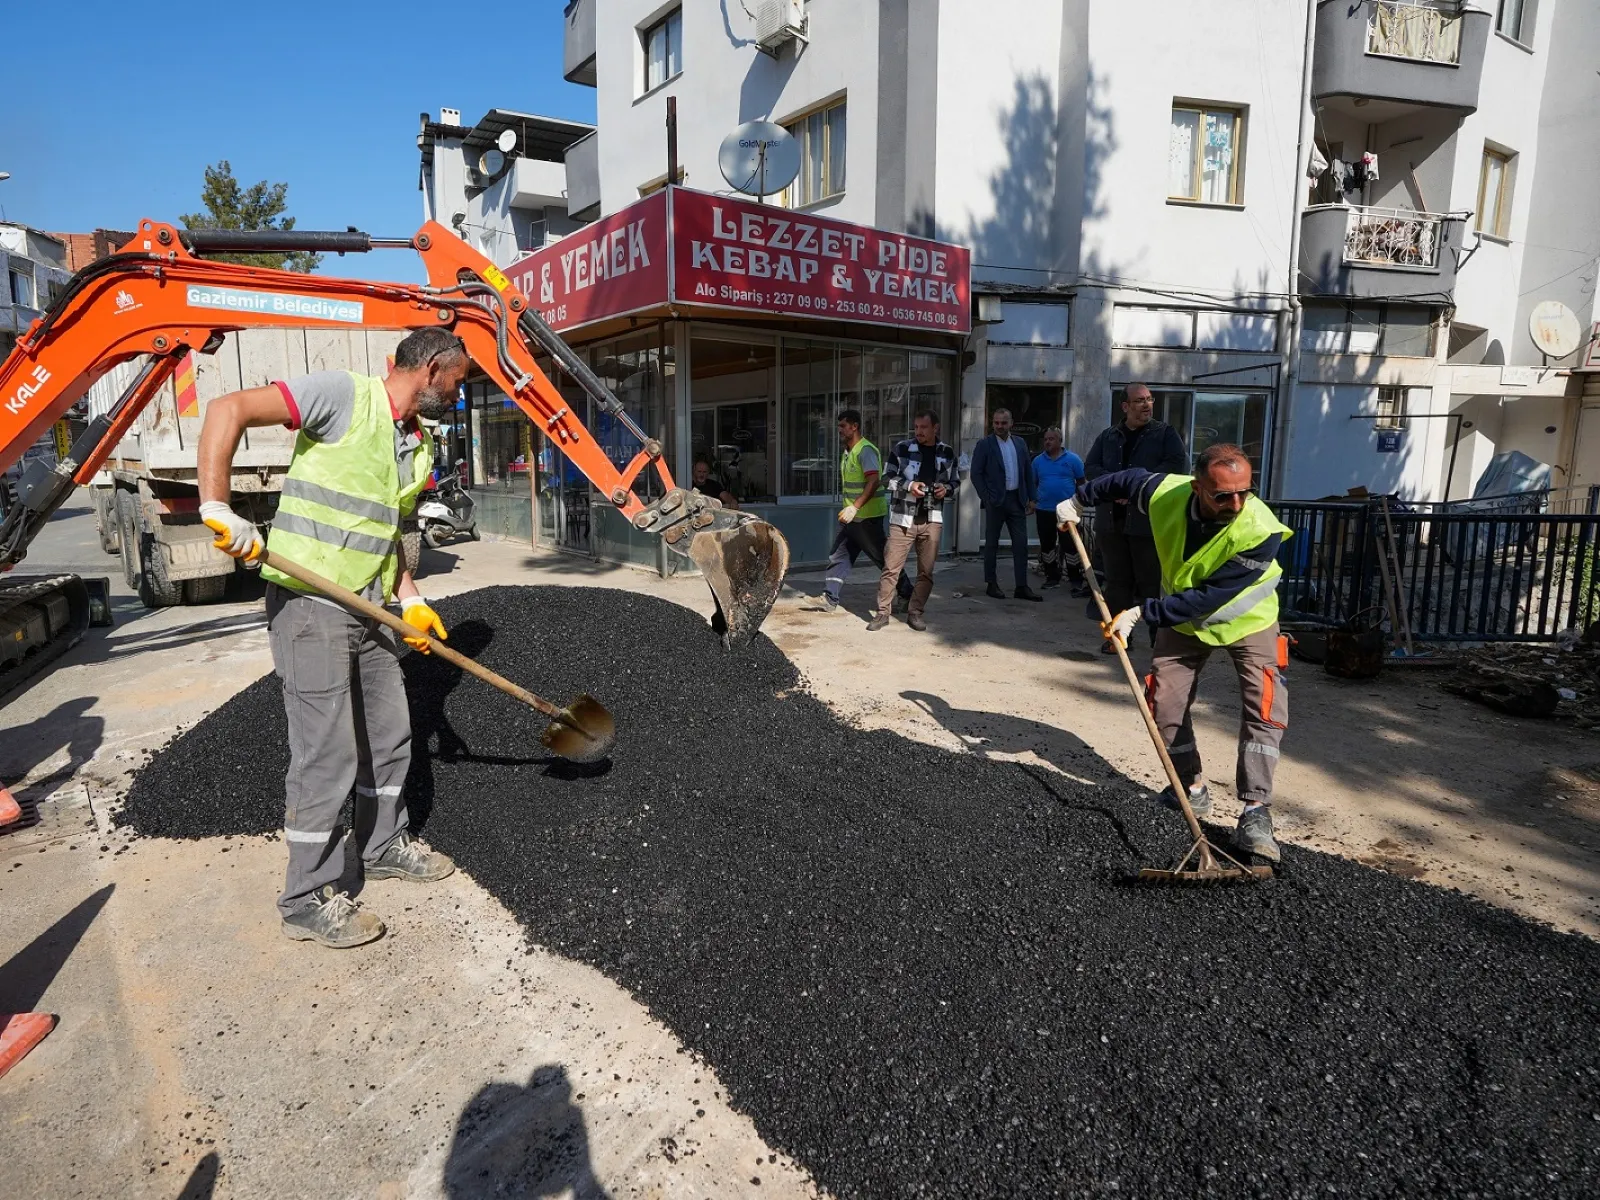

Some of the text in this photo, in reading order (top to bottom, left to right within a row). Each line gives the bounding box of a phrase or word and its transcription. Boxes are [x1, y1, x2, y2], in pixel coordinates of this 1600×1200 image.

[738, 140, 781, 149] GoldMster
[541, 261, 555, 303] &
[560, 218, 650, 295] YEMEK
[712, 206, 947, 278] LEZZET PİDE
[691, 240, 960, 306] KEBAP & YEMEK
[186, 289, 363, 319] Gaziemir Belediyesi
[695, 282, 716, 297] Alo
[720, 284, 763, 306] Sipariş
[773, 291, 794, 306] 237
[798, 294, 811, 308] 09
[814, 297, 828, 310] 09
[836, 300, 855, 313] 253
[858, 302, 870, 315] 60
[872, 304, 884, 317] 23
[892, 307, 915, 321] 0536
[917, 310, 933, 323] 745
[934, 312, 945, 324] 08
[947, 314, 958, 326] 05
[4, 364, 52, 415] KALE
